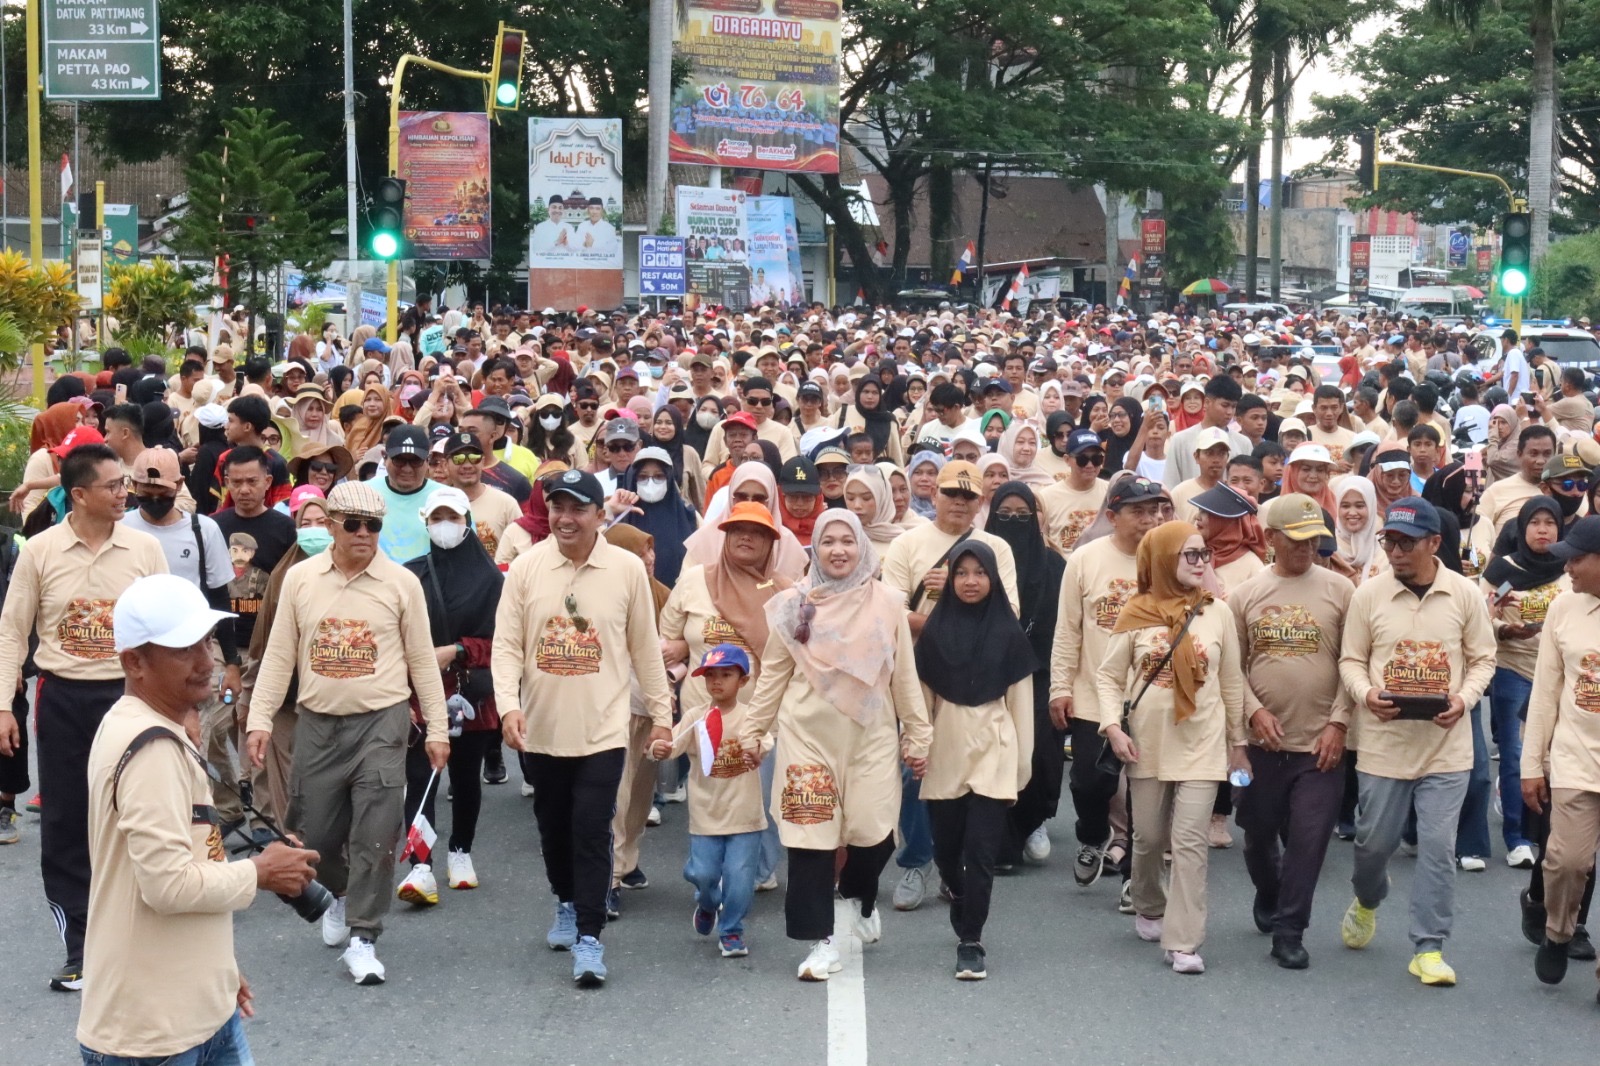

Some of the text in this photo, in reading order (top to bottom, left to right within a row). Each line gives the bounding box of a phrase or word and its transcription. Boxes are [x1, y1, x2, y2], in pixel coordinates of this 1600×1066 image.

[57, 8, 145, 19] DATUK PATTIMANG
[89, 24, 127, 34] 33 Km
[713, 15, 802, 41] DIRGAHAYU
[58, 49, 107, 59] MAKAM
[58, 64, 131, 75] PETTA PAO
[91, 79, 130, 89] 43 Km
[687, 215, 716, 226] BUPATI
[717, 217, 733, 226] CUP
[466, 231, 480, 239] 110
[690, 225, 738, 236] TAHUN 2026
[645, 254, 654, 265] P
[642, 271, 661, 280] REST
[662, 272, 684, 280] AREA
[661, 283, 678, 291] 50M
[795, 466, 807, 481] LA
[1096, 601, 1121, 618] Luw
[58, 624, 114, 642] Luwu Uta
[702, 620, 735, 637] Luwu
[1281, 626, 1319, 642] Utara
[310, 644, 374, 663] Luwu Utara
[535, 642, 600, 660] Luwu Utara
[1383, 665, 1450, 683] Luwu Utara
[780, 791, 835, 812] Luwu Utara
